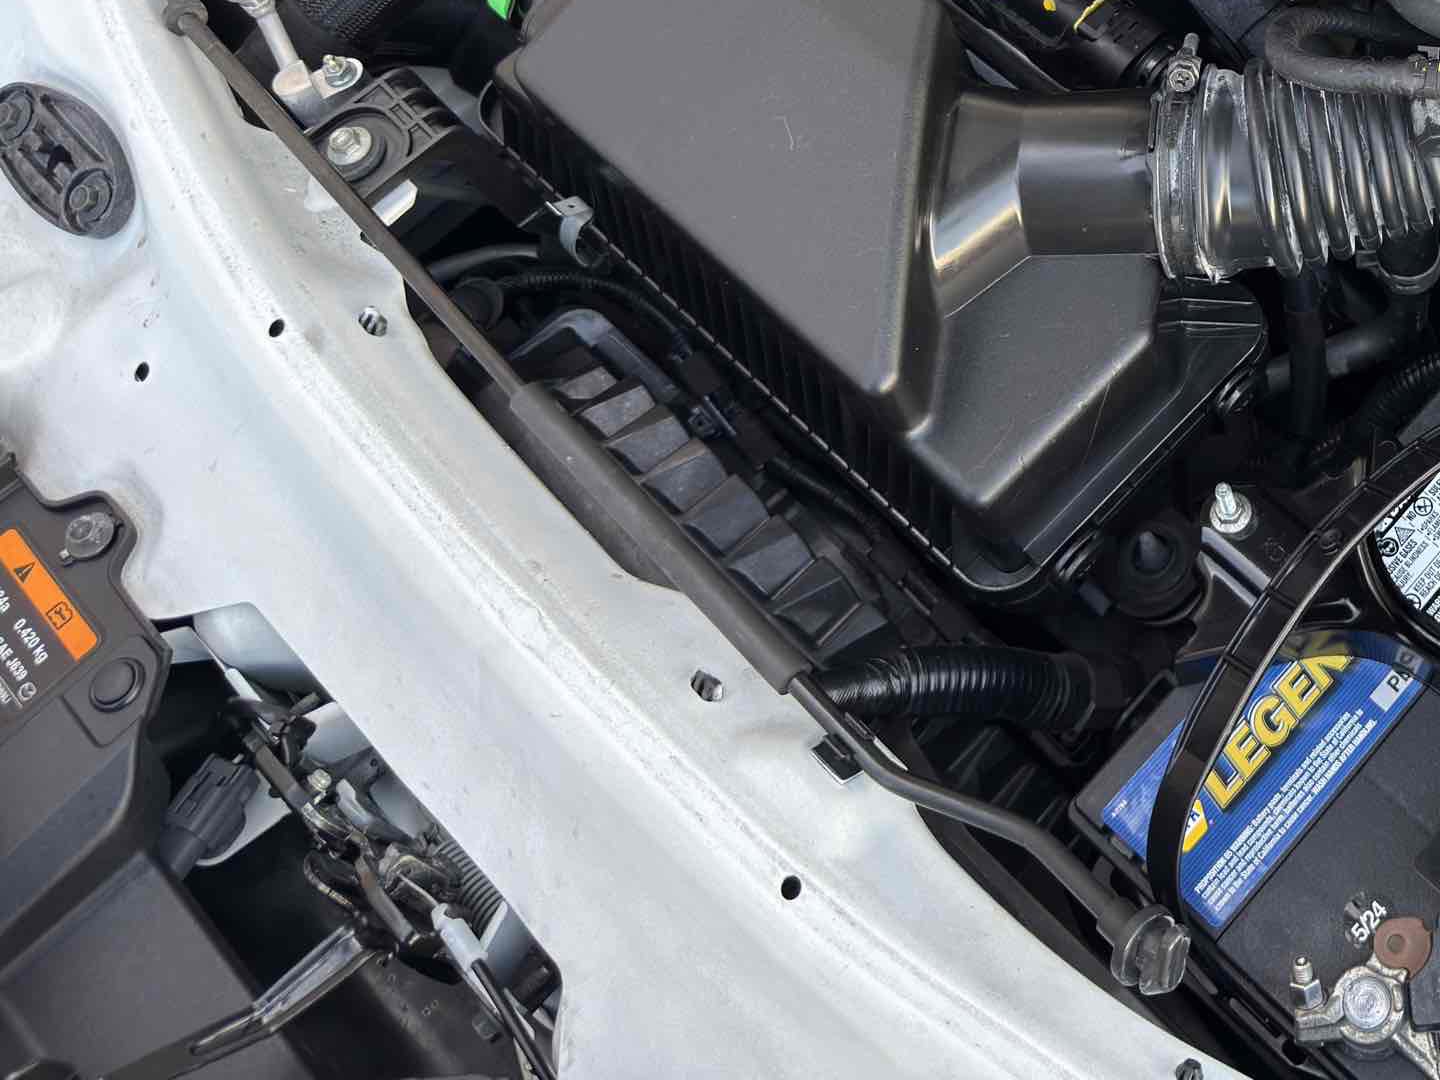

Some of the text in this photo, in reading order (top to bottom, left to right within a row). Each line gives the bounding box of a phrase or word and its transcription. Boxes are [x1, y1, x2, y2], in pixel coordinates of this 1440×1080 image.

[1404, 509, 1417, 522] NO
[1398, 537, 1418, 559] GASES
[1423, 565, 1437, 579] OUT
[1418, 578, 1437, 599] REACH
[13, 617, 40, 649] 0.420
[32, 643, 49, 665] kg
[6, 657, 28, 681] J639
[1203, 653, 1354, 810] LEGEN
[1318, 741, 1335, 760] State
[1193, 855, 1228, 895] PROPOSITION
[1222, 847, 1235, 861] 65
[1347, 897, 1390, 943] 5/24
